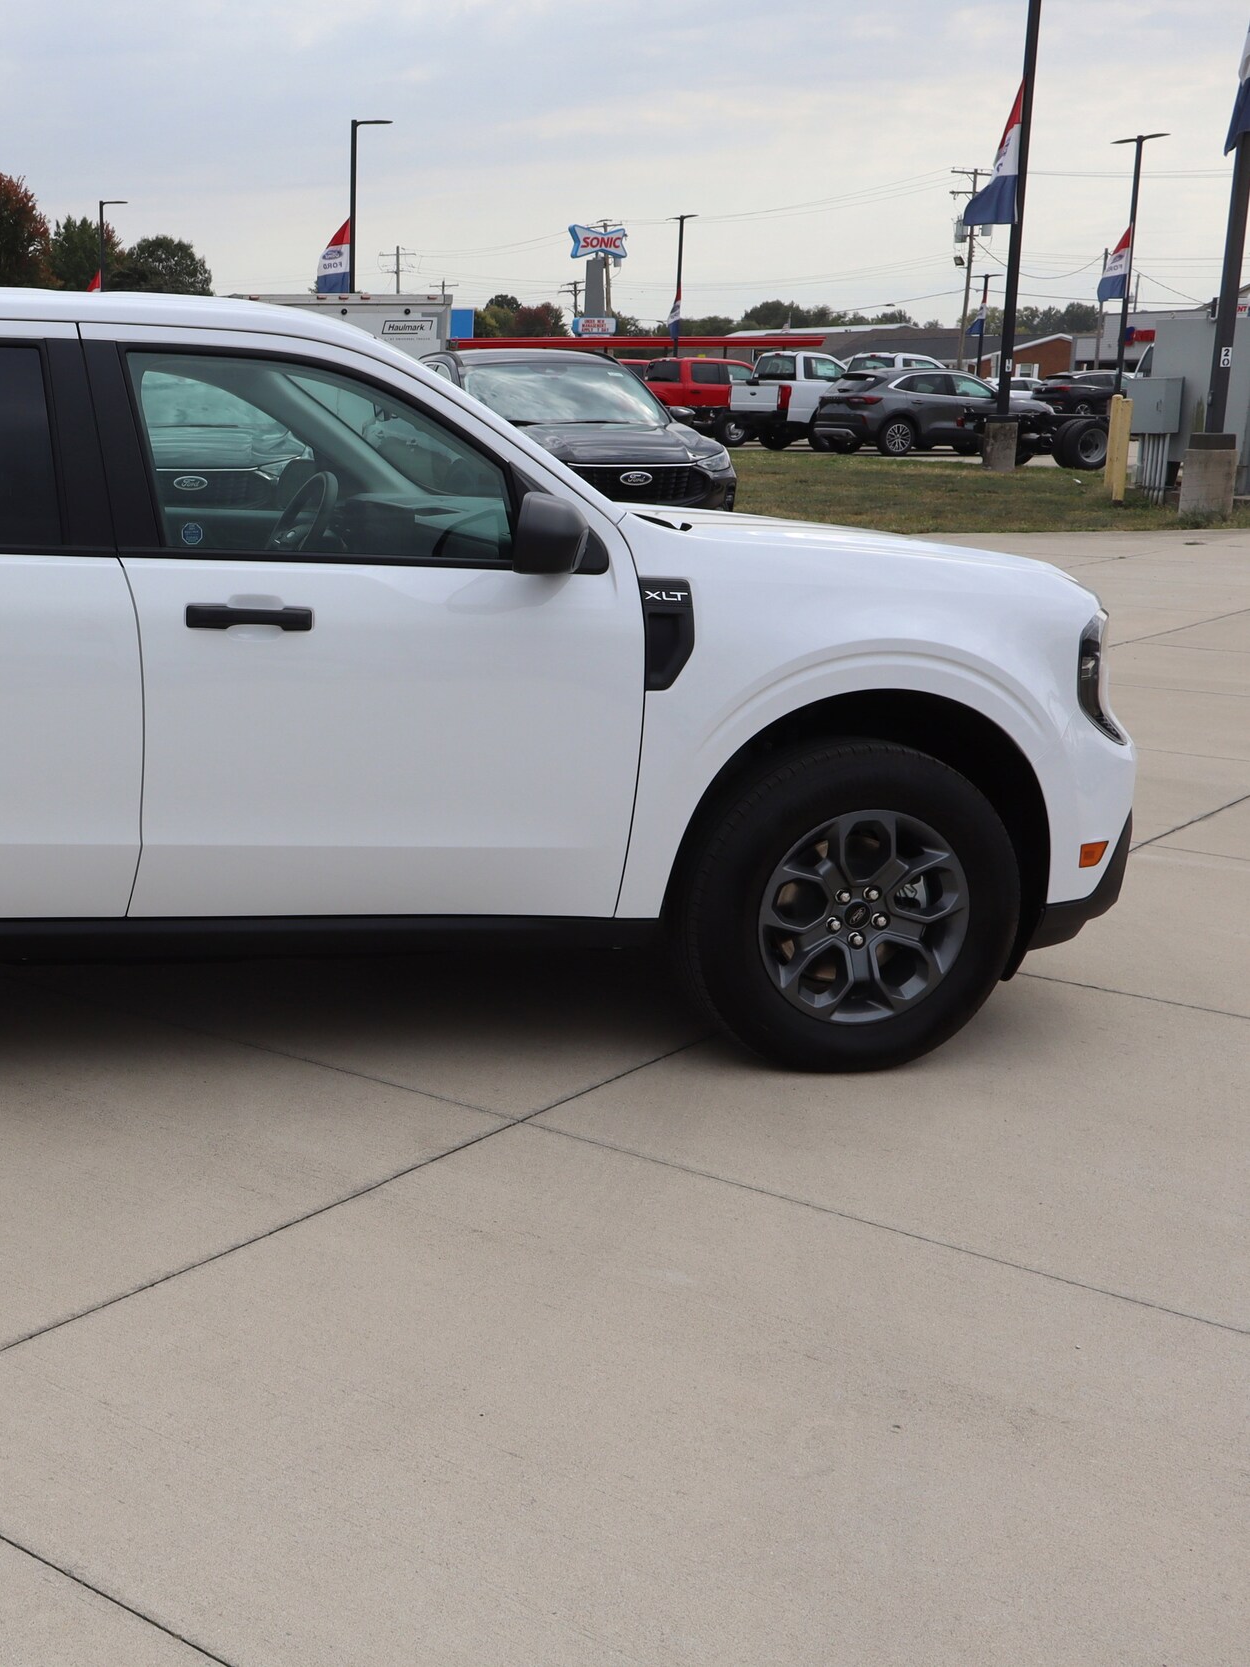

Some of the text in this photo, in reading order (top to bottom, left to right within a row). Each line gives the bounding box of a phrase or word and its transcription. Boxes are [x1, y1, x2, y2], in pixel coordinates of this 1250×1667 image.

[580, 236, 622, 248] SONIC
[388, 323, 425, 331] Haulmark
[644, 590, 688, 601] XLT
